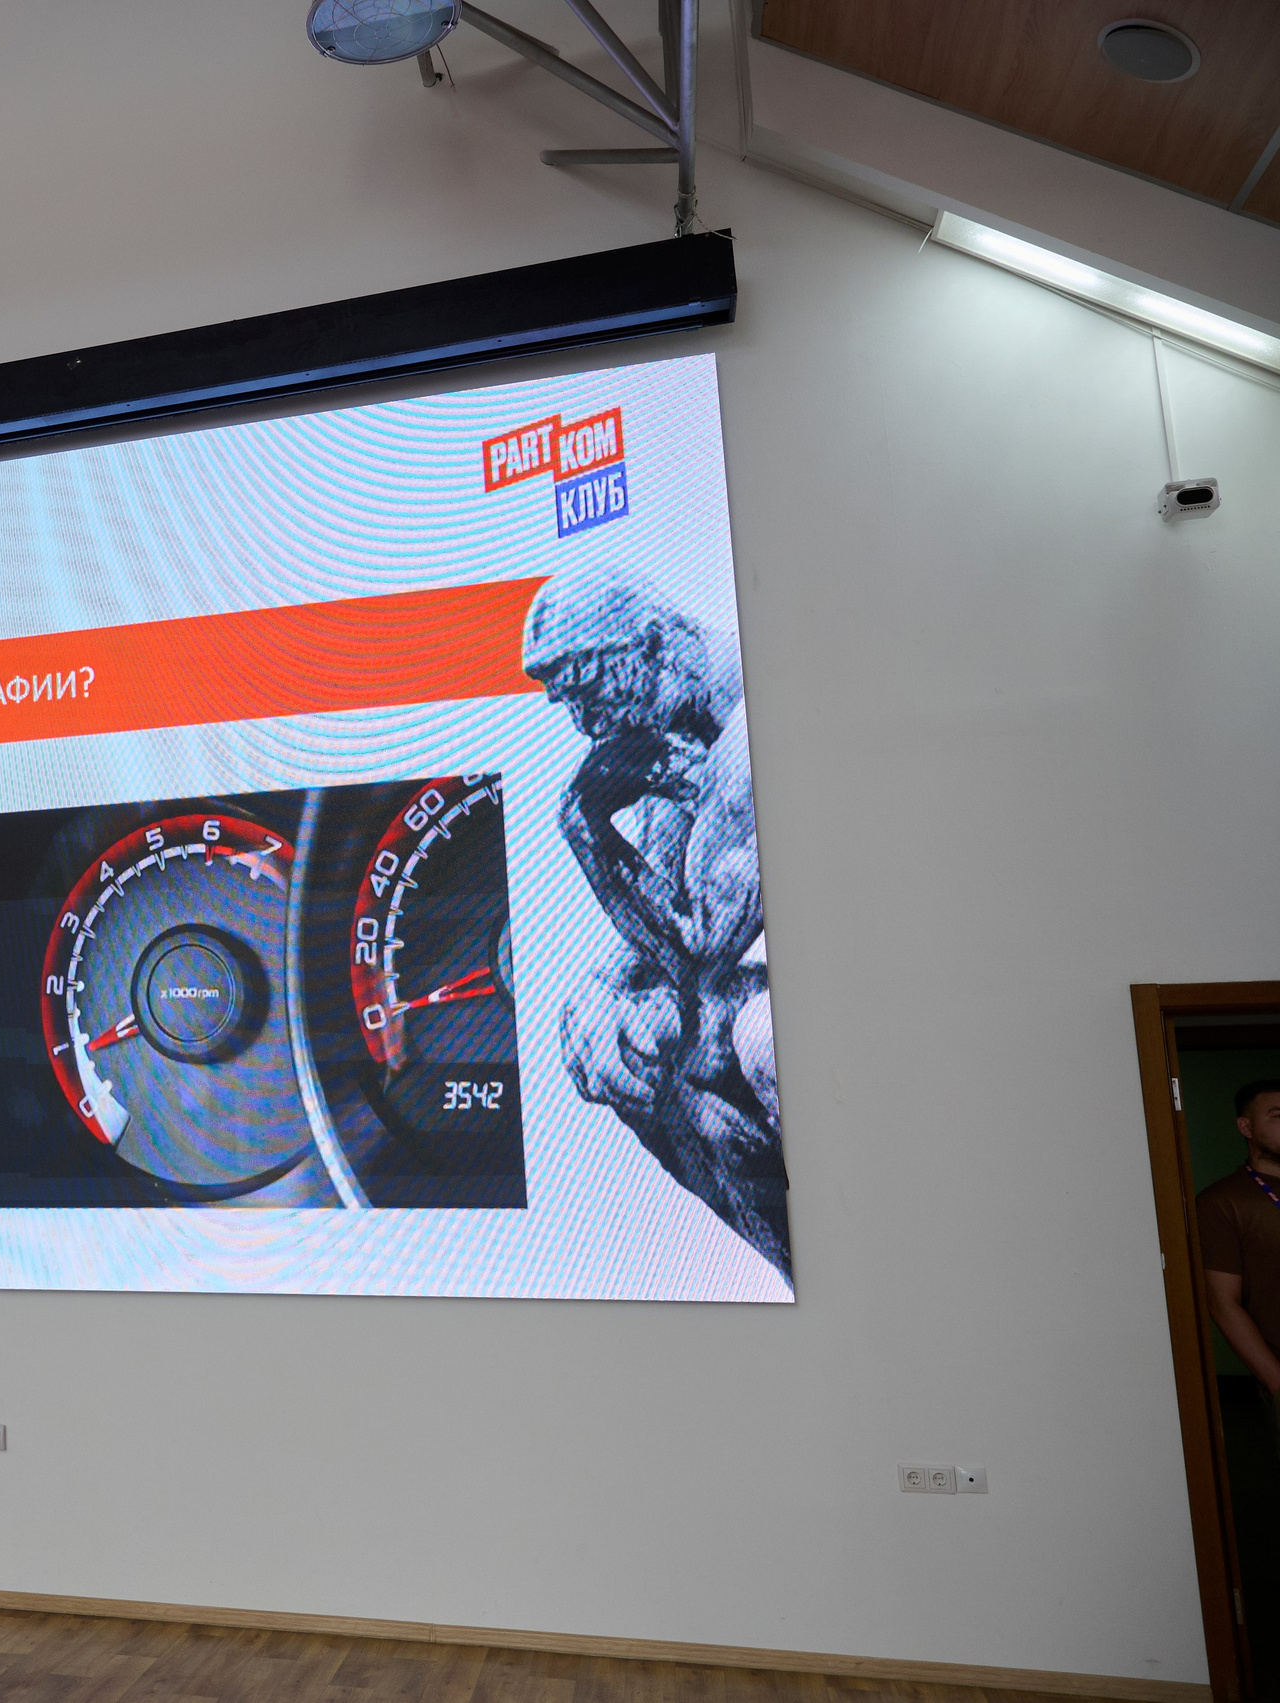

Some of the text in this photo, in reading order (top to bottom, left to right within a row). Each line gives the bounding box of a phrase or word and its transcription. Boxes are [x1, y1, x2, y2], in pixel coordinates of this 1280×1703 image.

[490, 417, 617, 482] PART KOM
[560, 472, 626, 529] КЛУБ
[403, 788, 445, 832] 60
[145, 827, 165, 851] 5
[202, 819, 221, 841] 6
[263, 835, 283, 856] 7
[99, 860, 115, 883] 4
[370, 850, 400, 898] 40
[60, 911, 81, 934] 3
[355, 917, 379, 965] 20
[46, 974, 64, 996] 2
[362, 1003, 387, 1030] 0
[52, 1042, 70, 1056] 1
[78, 1096, 97, 1118] 0
[442, 1080, 504, 1110] 3542
